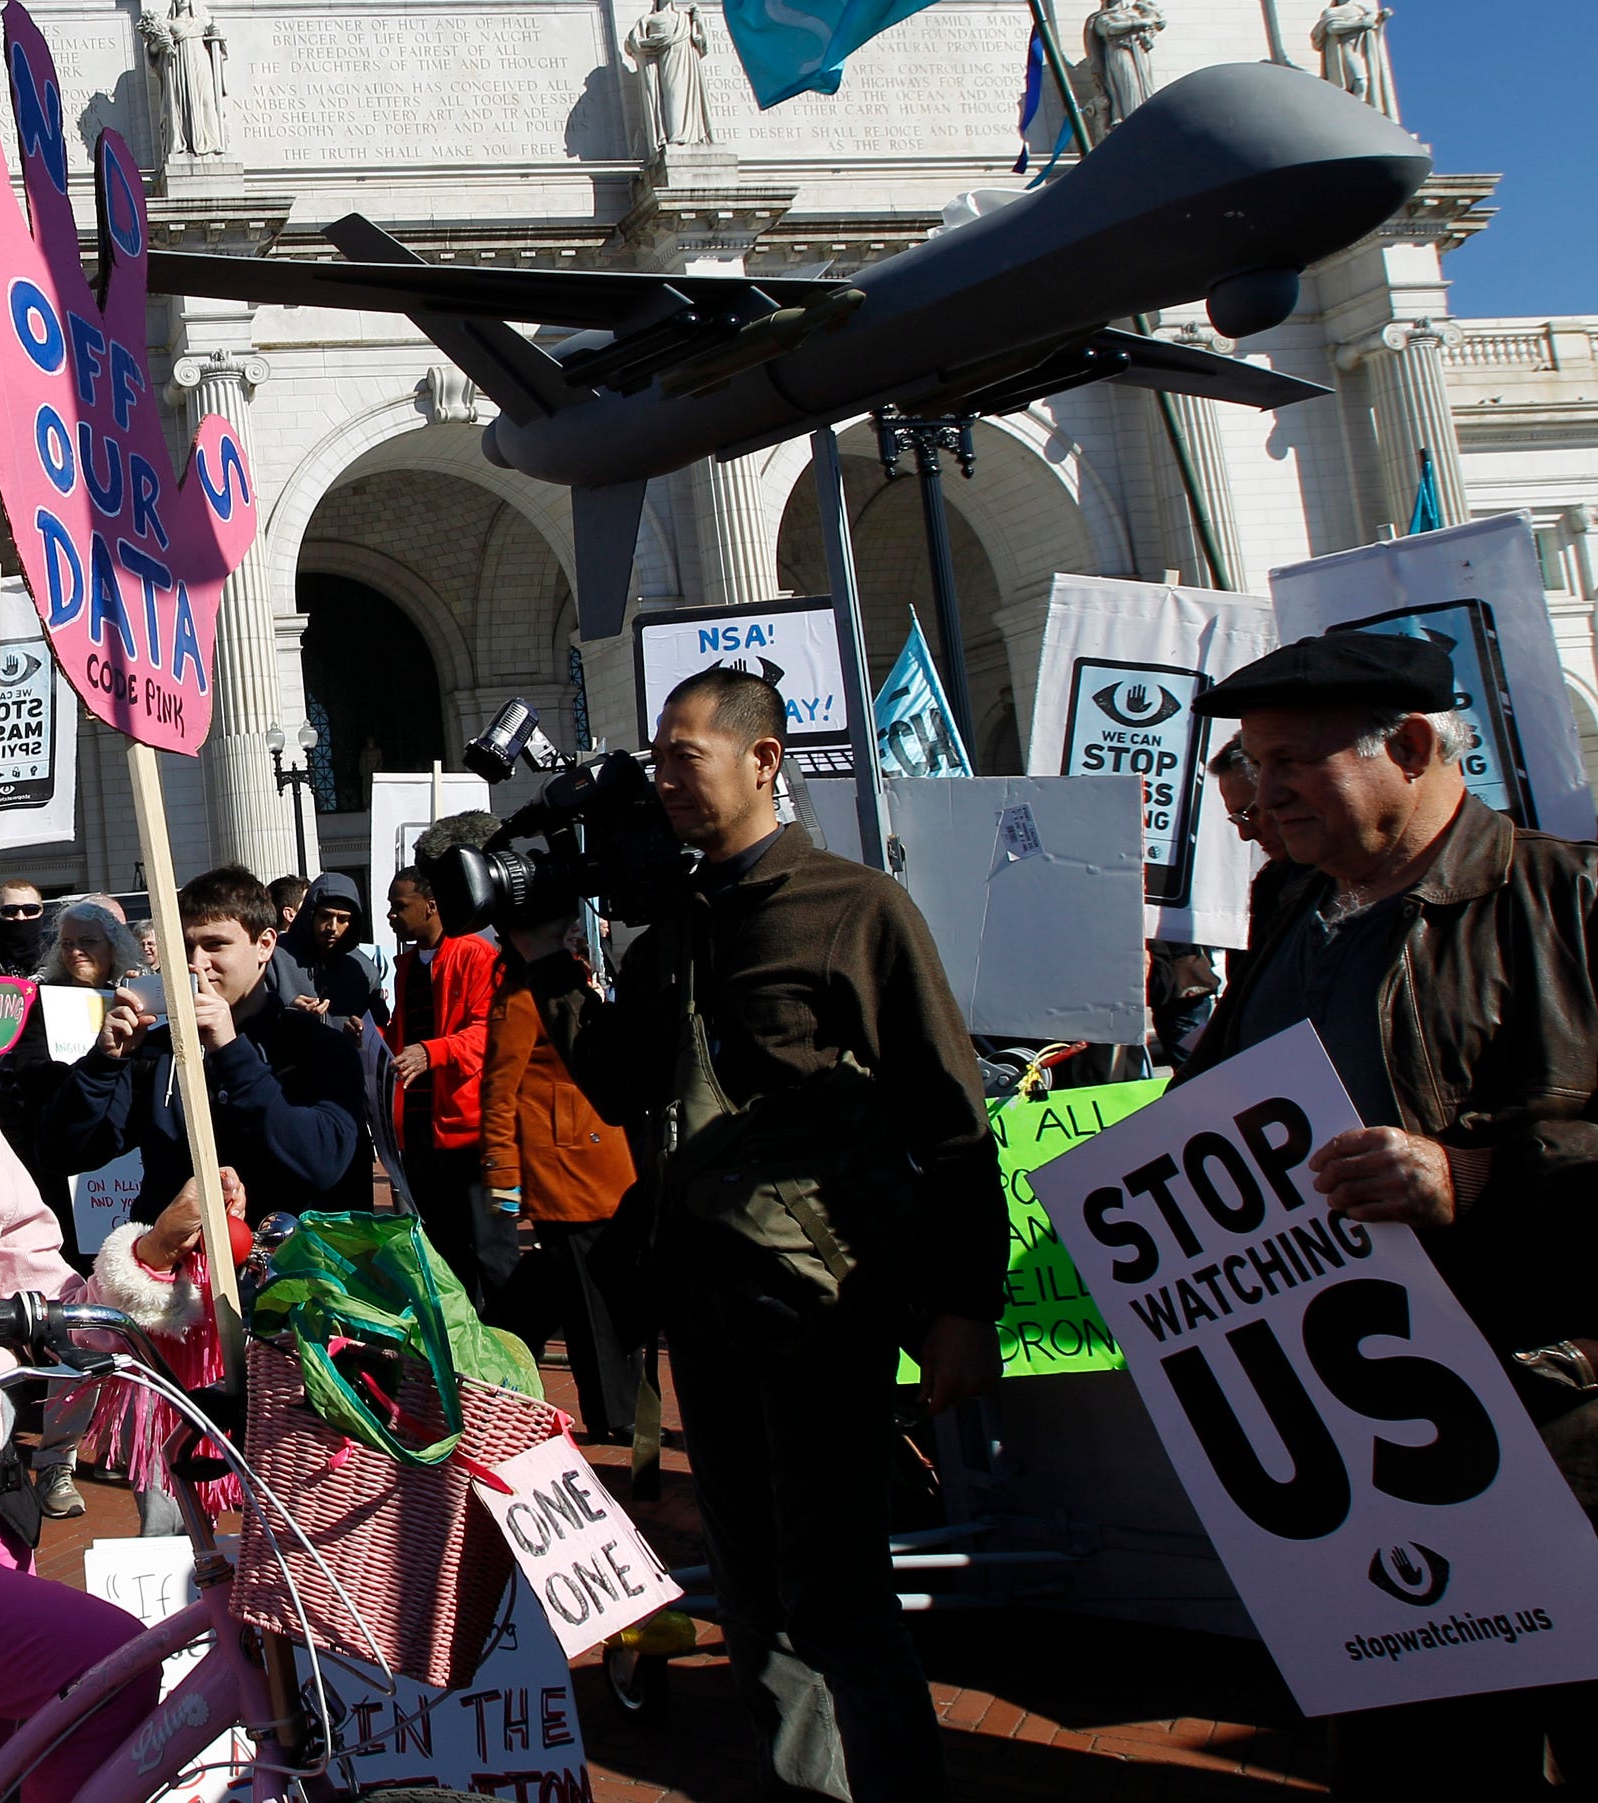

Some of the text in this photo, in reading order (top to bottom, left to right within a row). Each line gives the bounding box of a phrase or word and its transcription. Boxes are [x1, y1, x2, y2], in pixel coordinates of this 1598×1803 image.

[274, 17, 541, 31] SWEETENER OF HUT AND OF HALL
[925, 15, 1021, 27] FAMILY MAIN
[273, 31, 541, 46] BRINGER OF LIFE OUT OF NAUGHT
[922, 28, 1006, 40] FOUNDATION
[298, 44, 522, 59] FREEDOM O FAIREST OF ALL
[876, 42, 938, 53] NATURAL
[249, 57, 569, 74] THE DAUGHTERS OF TIME AND THOUGHT
[851, 63, 993, 75] ARTS CONTROLLING
[307, 83, 404, 95] IMAGINATION
[413, 82, 443, 93] HAS
[450, 81, 538, 92] CONCEIVED
[546, 80, 573, 91] ALL
[861, 76, 1022, 89] HIGHWAYS FOR GOODS
[233, 94, 520, 111] NUMBERS AND LETTERS ALL TOOLS
[863, 88, 987, 102] THE OCEAN AND
[242, 107, 549, 124] AND SHELTERS EVERY ART AND TRADE
[712, 102, 1017, 117] THE ETHER CARRY HUMAN THOUGH
[244, 121, 517, 138] PHILOSOPHY AND POETRY AND ALL
[714, 125, 1015, 139] THE DESERT SHALL REJOICE AND BLOSSO
[282, 143, 561, 160] THE TRUTH SHALL MAKE YOU FREE
[827, 139, 923, 151] AS THE ROSE
[7, 276, 144, 432] OFF
[34, 402, 169, 550] OUR
[35, 505, 210, 696] DATA
[698, 624, 775, 653] NSA!
[87, 654, 187, 738] CODE PINK
[785, 694, 833, 723] AY!
[1102, 731, 1162, 747] WE CAN
[1082, 744, 1178, 777] STOP
[87, 1180, 106, 1192] ON
[1083, 1096, 1313, 1285] STOP
[90, 1197, 114, 1208] AND
[1129, 1208, 1373, 1343] WATCHING
[1159, 1277, 1500, 1541] US
[505, 1470, 606, 1557] ONE
[545, 1540, 647, 1626] ONE
[1344, 1604, 1553, 1663] stopwatching.us
[459, 1687, 576, 1764] THE
